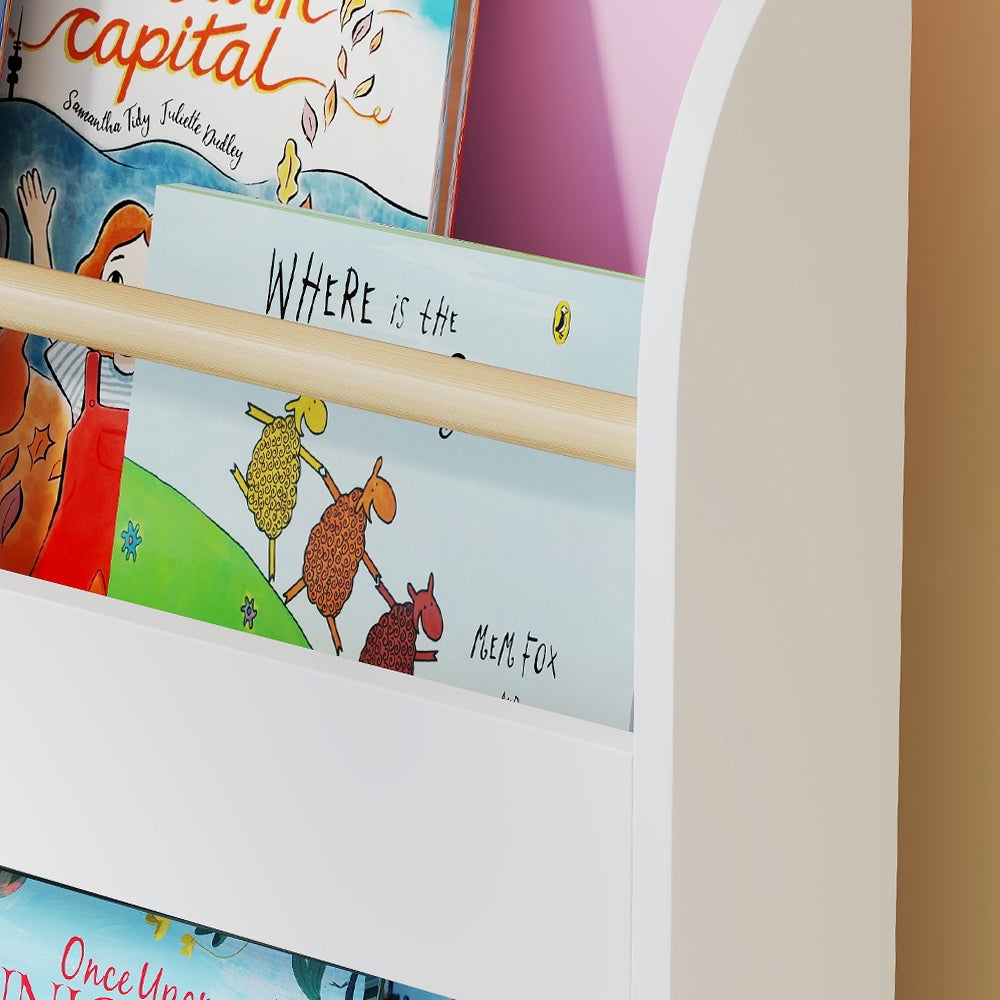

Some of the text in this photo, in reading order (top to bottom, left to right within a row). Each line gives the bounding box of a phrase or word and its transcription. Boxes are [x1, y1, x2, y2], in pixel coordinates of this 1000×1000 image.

[52, 5, 324, 104] capital
[63, 90, 244, 170] Samantha Tidy Juliette Dudley
[265, 248, 376, 324] WHERE
[470, 624, 558, 679] MEM FOX
[60, 936, 134, 995] Once
